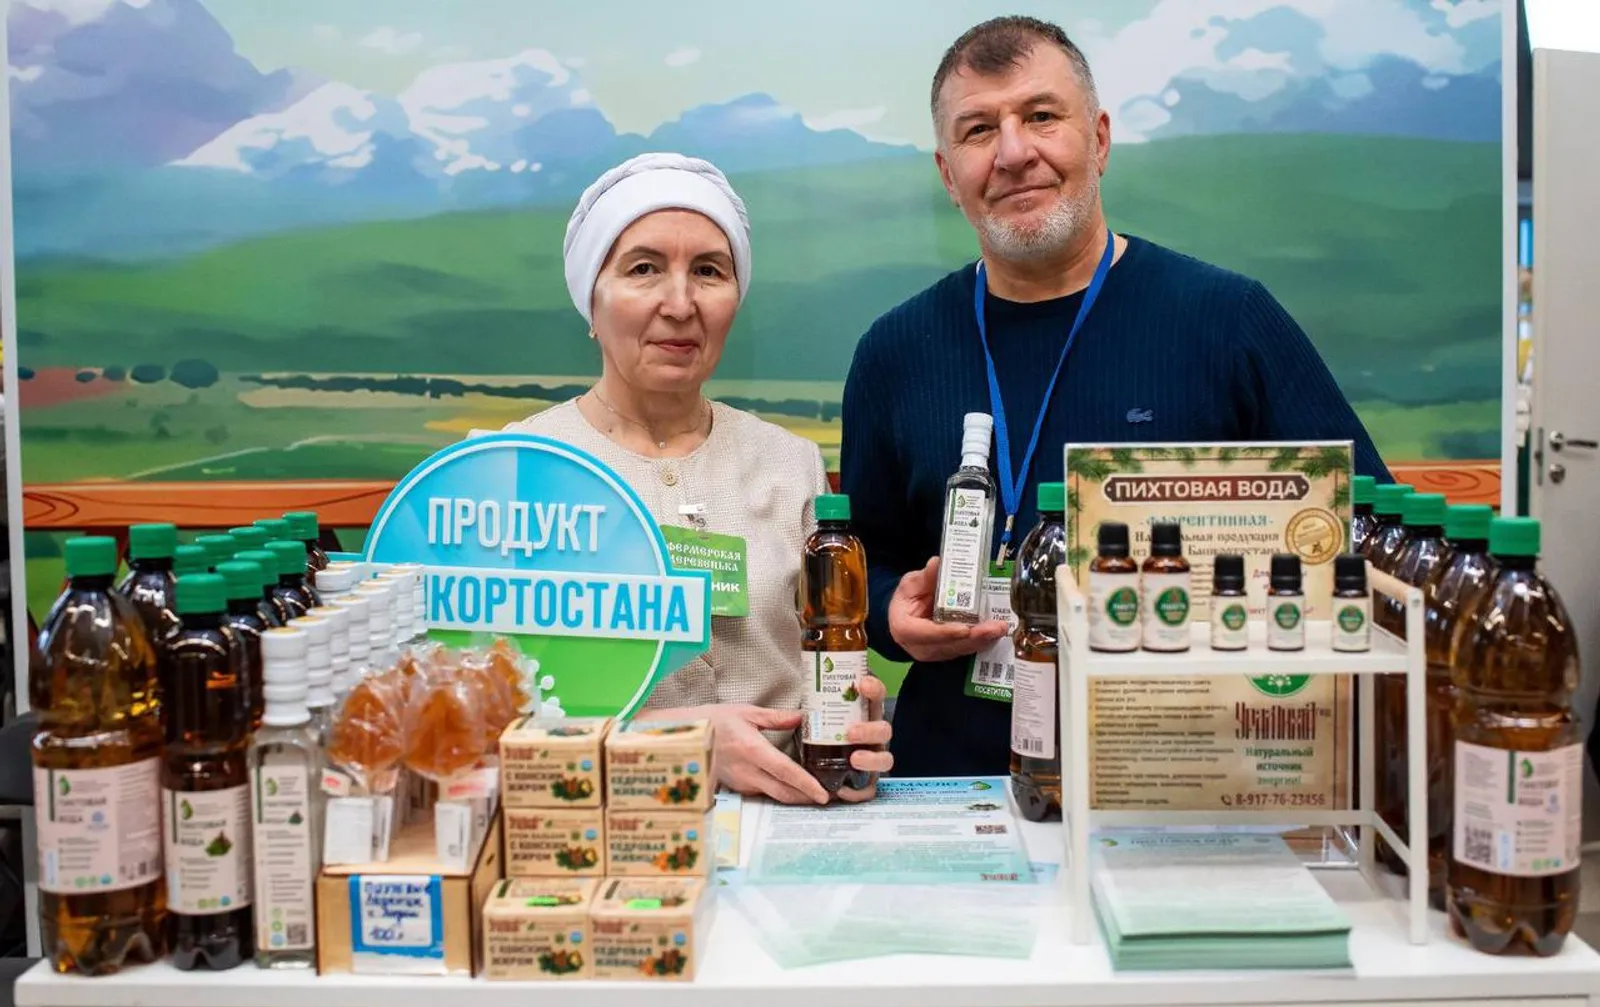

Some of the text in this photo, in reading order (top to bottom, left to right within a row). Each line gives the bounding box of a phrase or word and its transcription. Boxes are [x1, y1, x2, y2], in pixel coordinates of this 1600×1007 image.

[1115, 480, 1299, 499] ПИХТОВАЯ ВОДА
[427, 497, 606, 558] ПРОДУКТ
[711, 582, 741, 593] НИК
[425, 575, 691, 633] КОРТОСТАНА
[1246, 747, 1314, 759] Натуральный
[1256, 762, 1303, 772] источник
